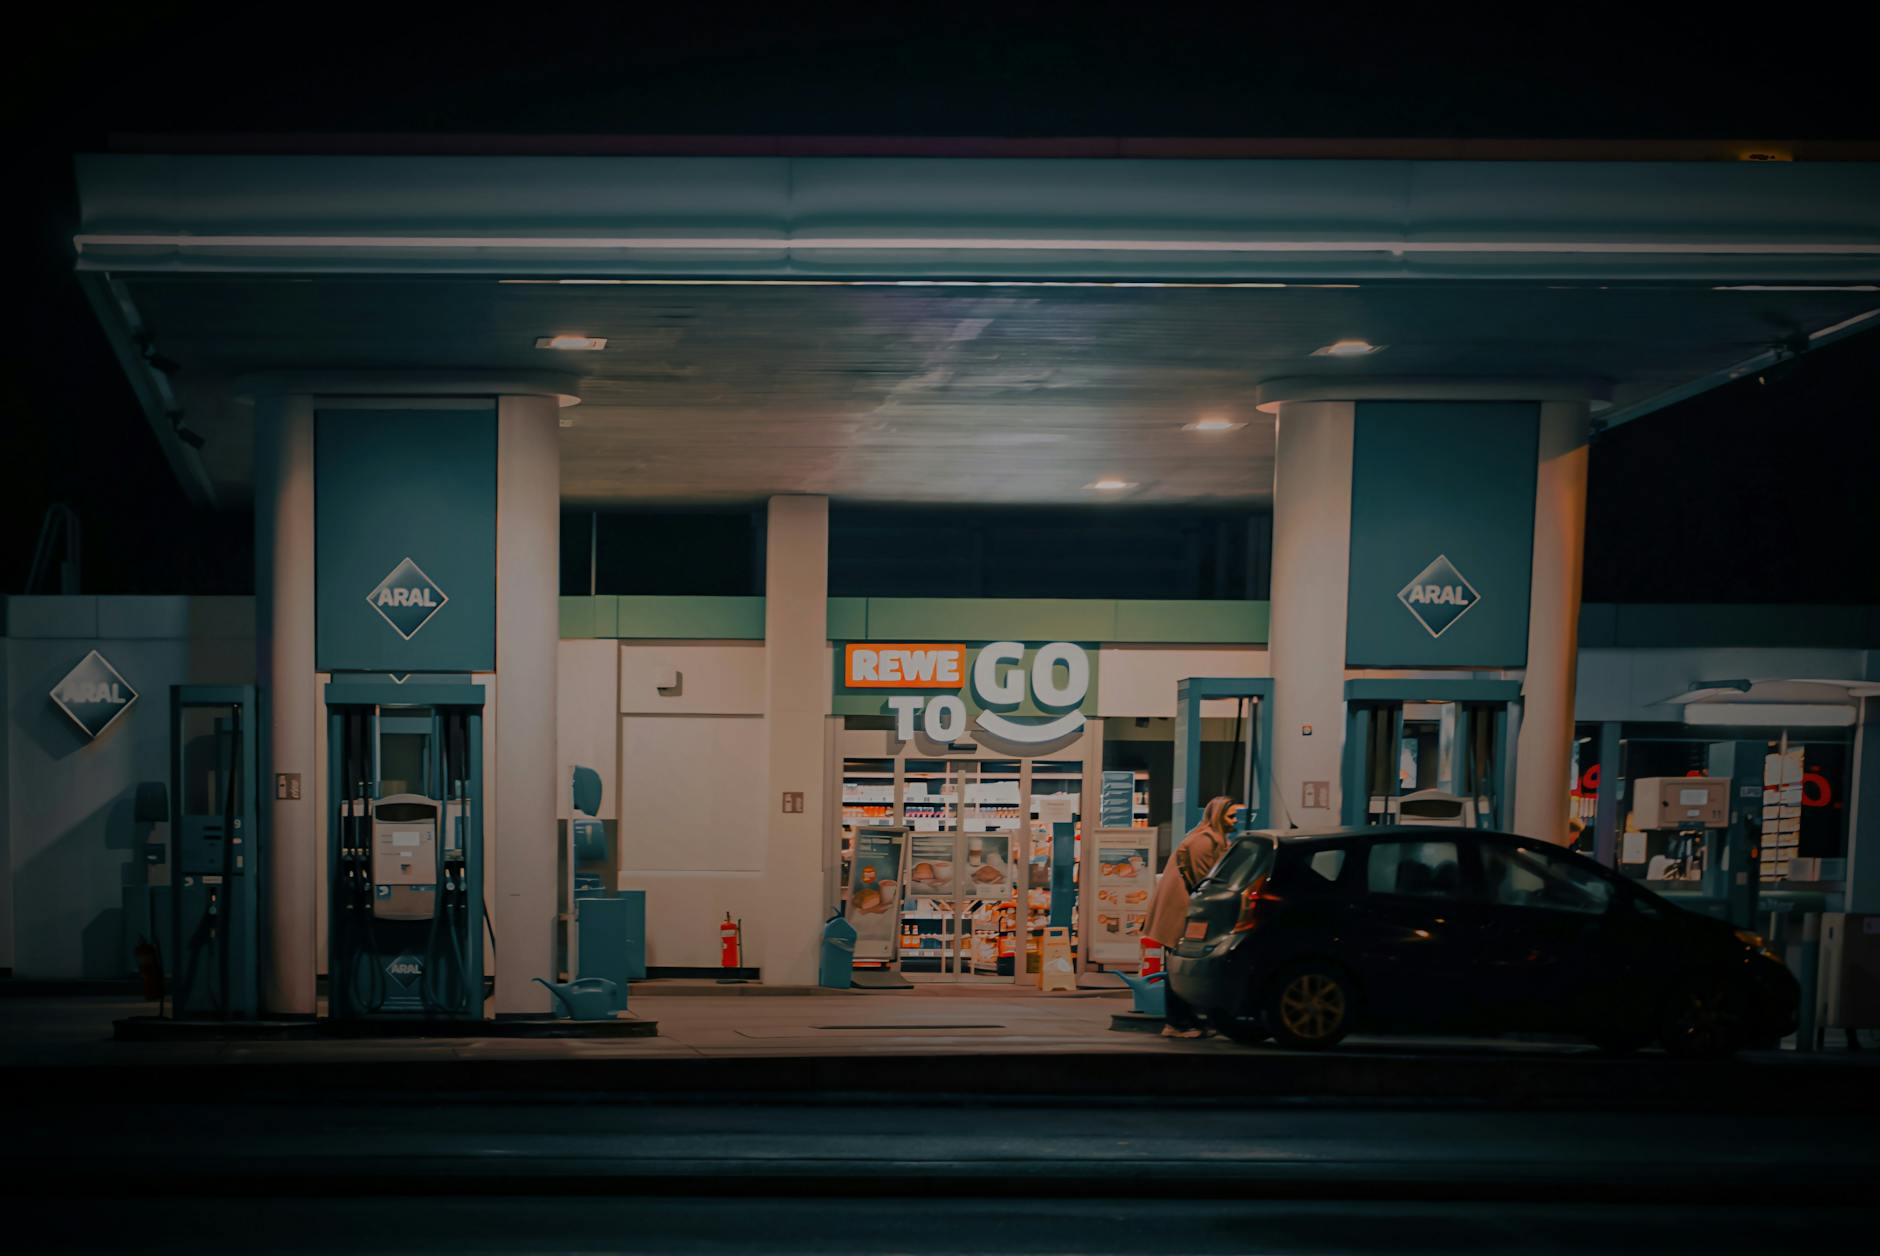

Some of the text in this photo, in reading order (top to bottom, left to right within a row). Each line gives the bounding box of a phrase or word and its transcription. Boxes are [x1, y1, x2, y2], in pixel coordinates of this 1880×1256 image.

[378, 587, 437, 608] ARAL
[1408, 585, 1469, 605] ARAL
[851, 649, 961, 682] REWE
[973, 641, 1090, 707] GO
[62, 681, 126, 704] ARAL
[887, 695, 968, 744] TO
[391, 963, 422, 975] ARAL
